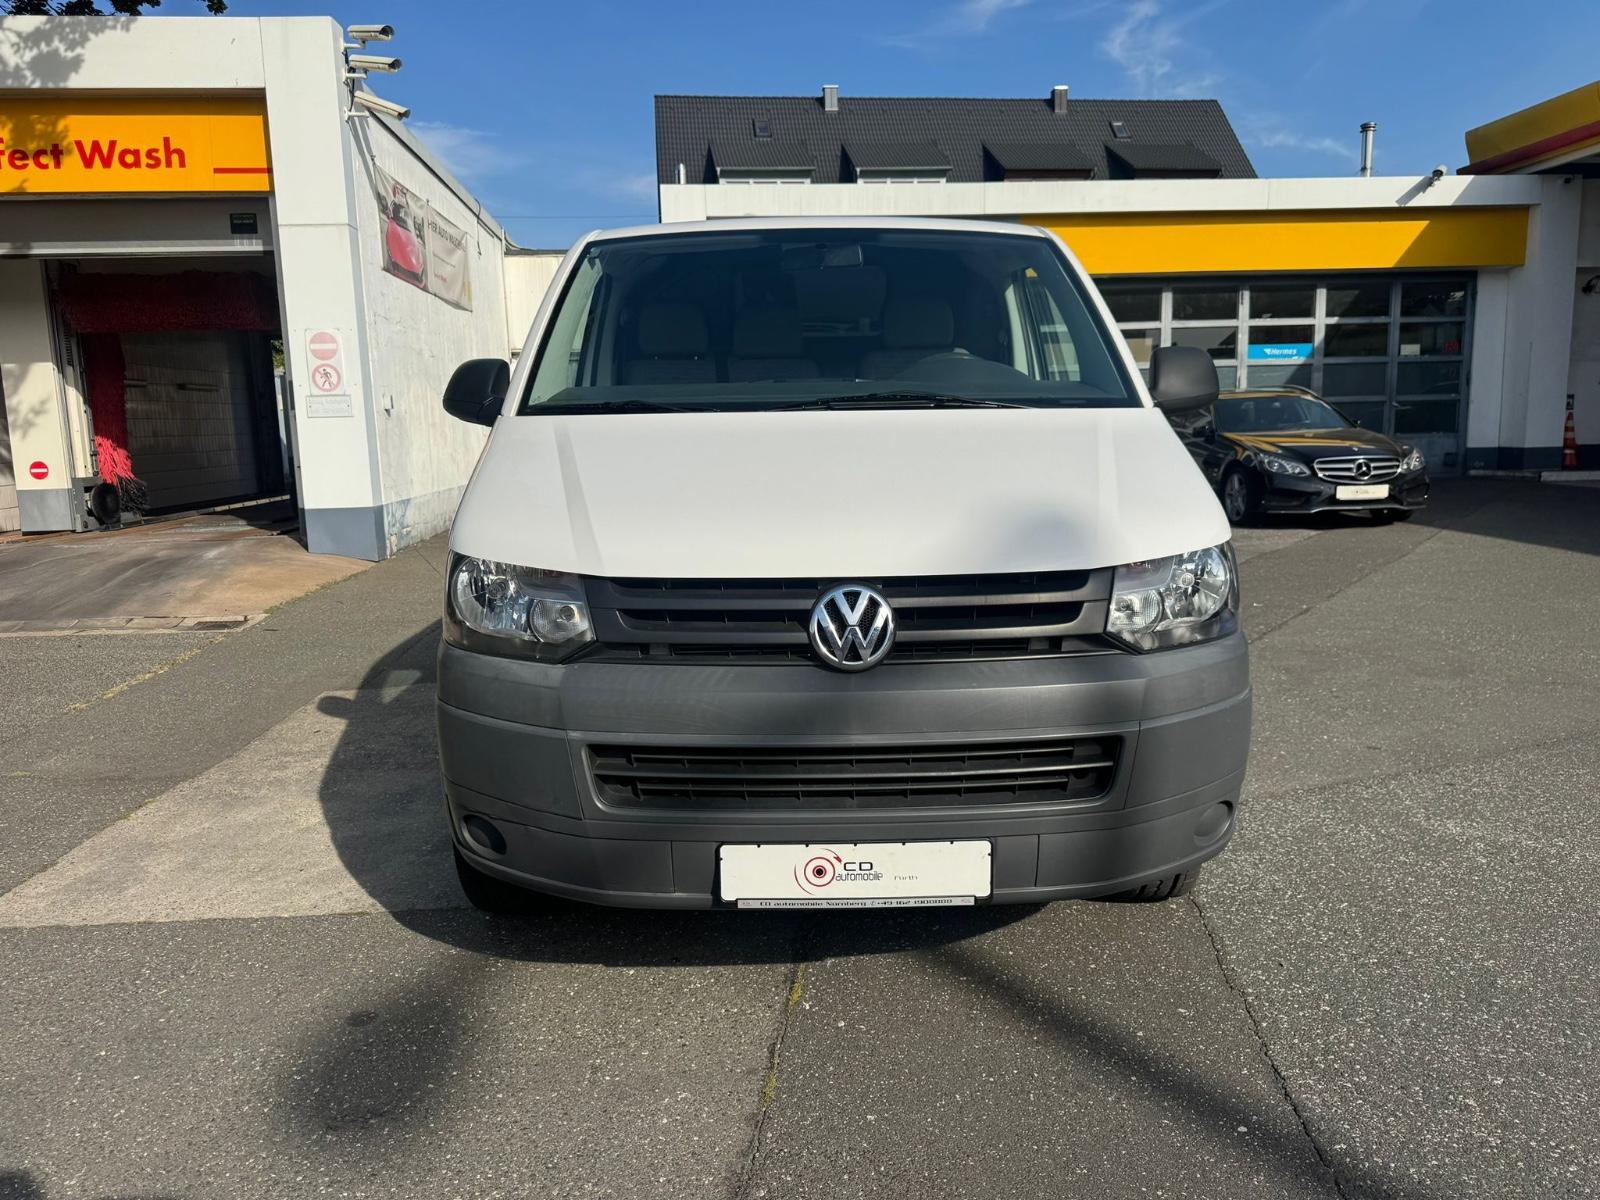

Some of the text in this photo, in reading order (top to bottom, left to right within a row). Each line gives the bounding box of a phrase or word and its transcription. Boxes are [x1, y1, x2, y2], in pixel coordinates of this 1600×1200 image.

[74, 136, 187, 169] Wash
[814, 588, 890, 665] VW
[835, 871, 883, 882] automobile
[843, 861, 873, 872] CD
